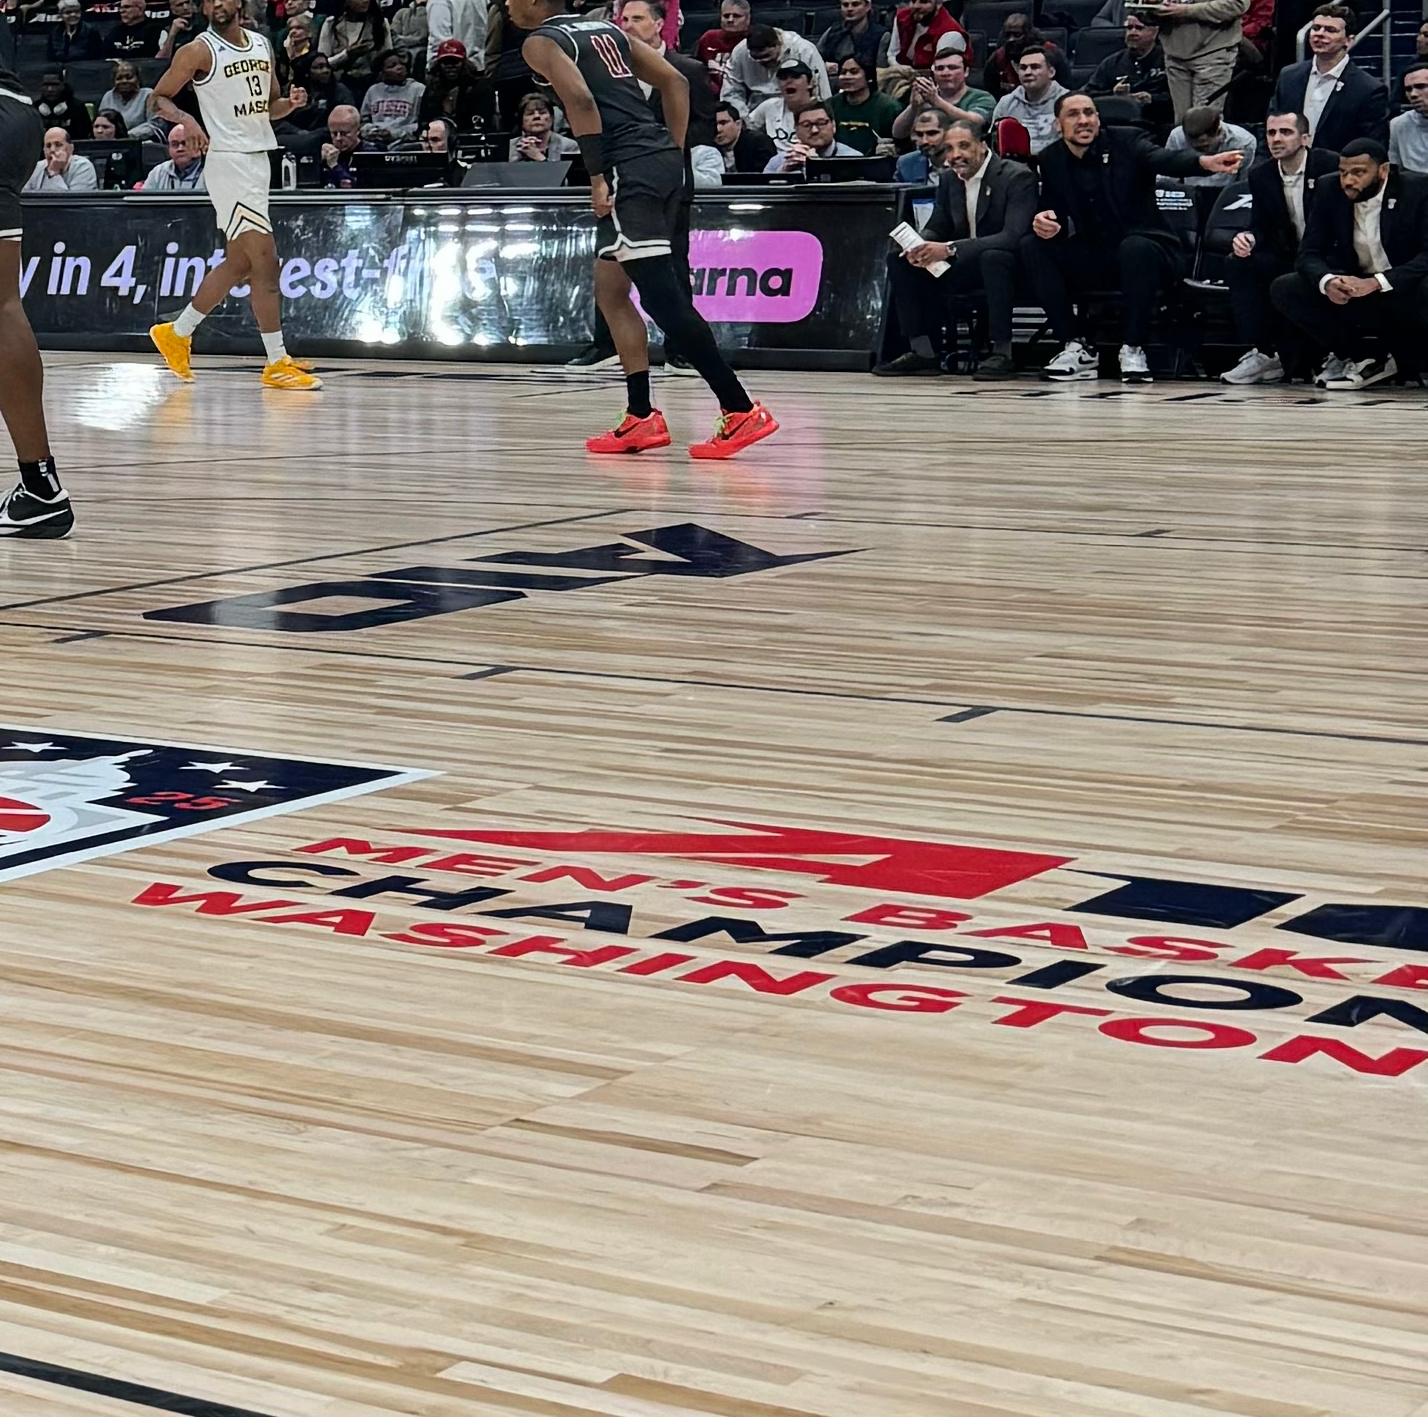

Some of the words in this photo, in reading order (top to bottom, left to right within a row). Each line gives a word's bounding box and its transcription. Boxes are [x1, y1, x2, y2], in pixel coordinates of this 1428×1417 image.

[246, 75, 262, 97] 13
[47, 241, 91, 296] in
[101, 244, 145, 305] 4,
[689, 266, 793, 298] arna
[294, 834, 800, 912] MEN'S
